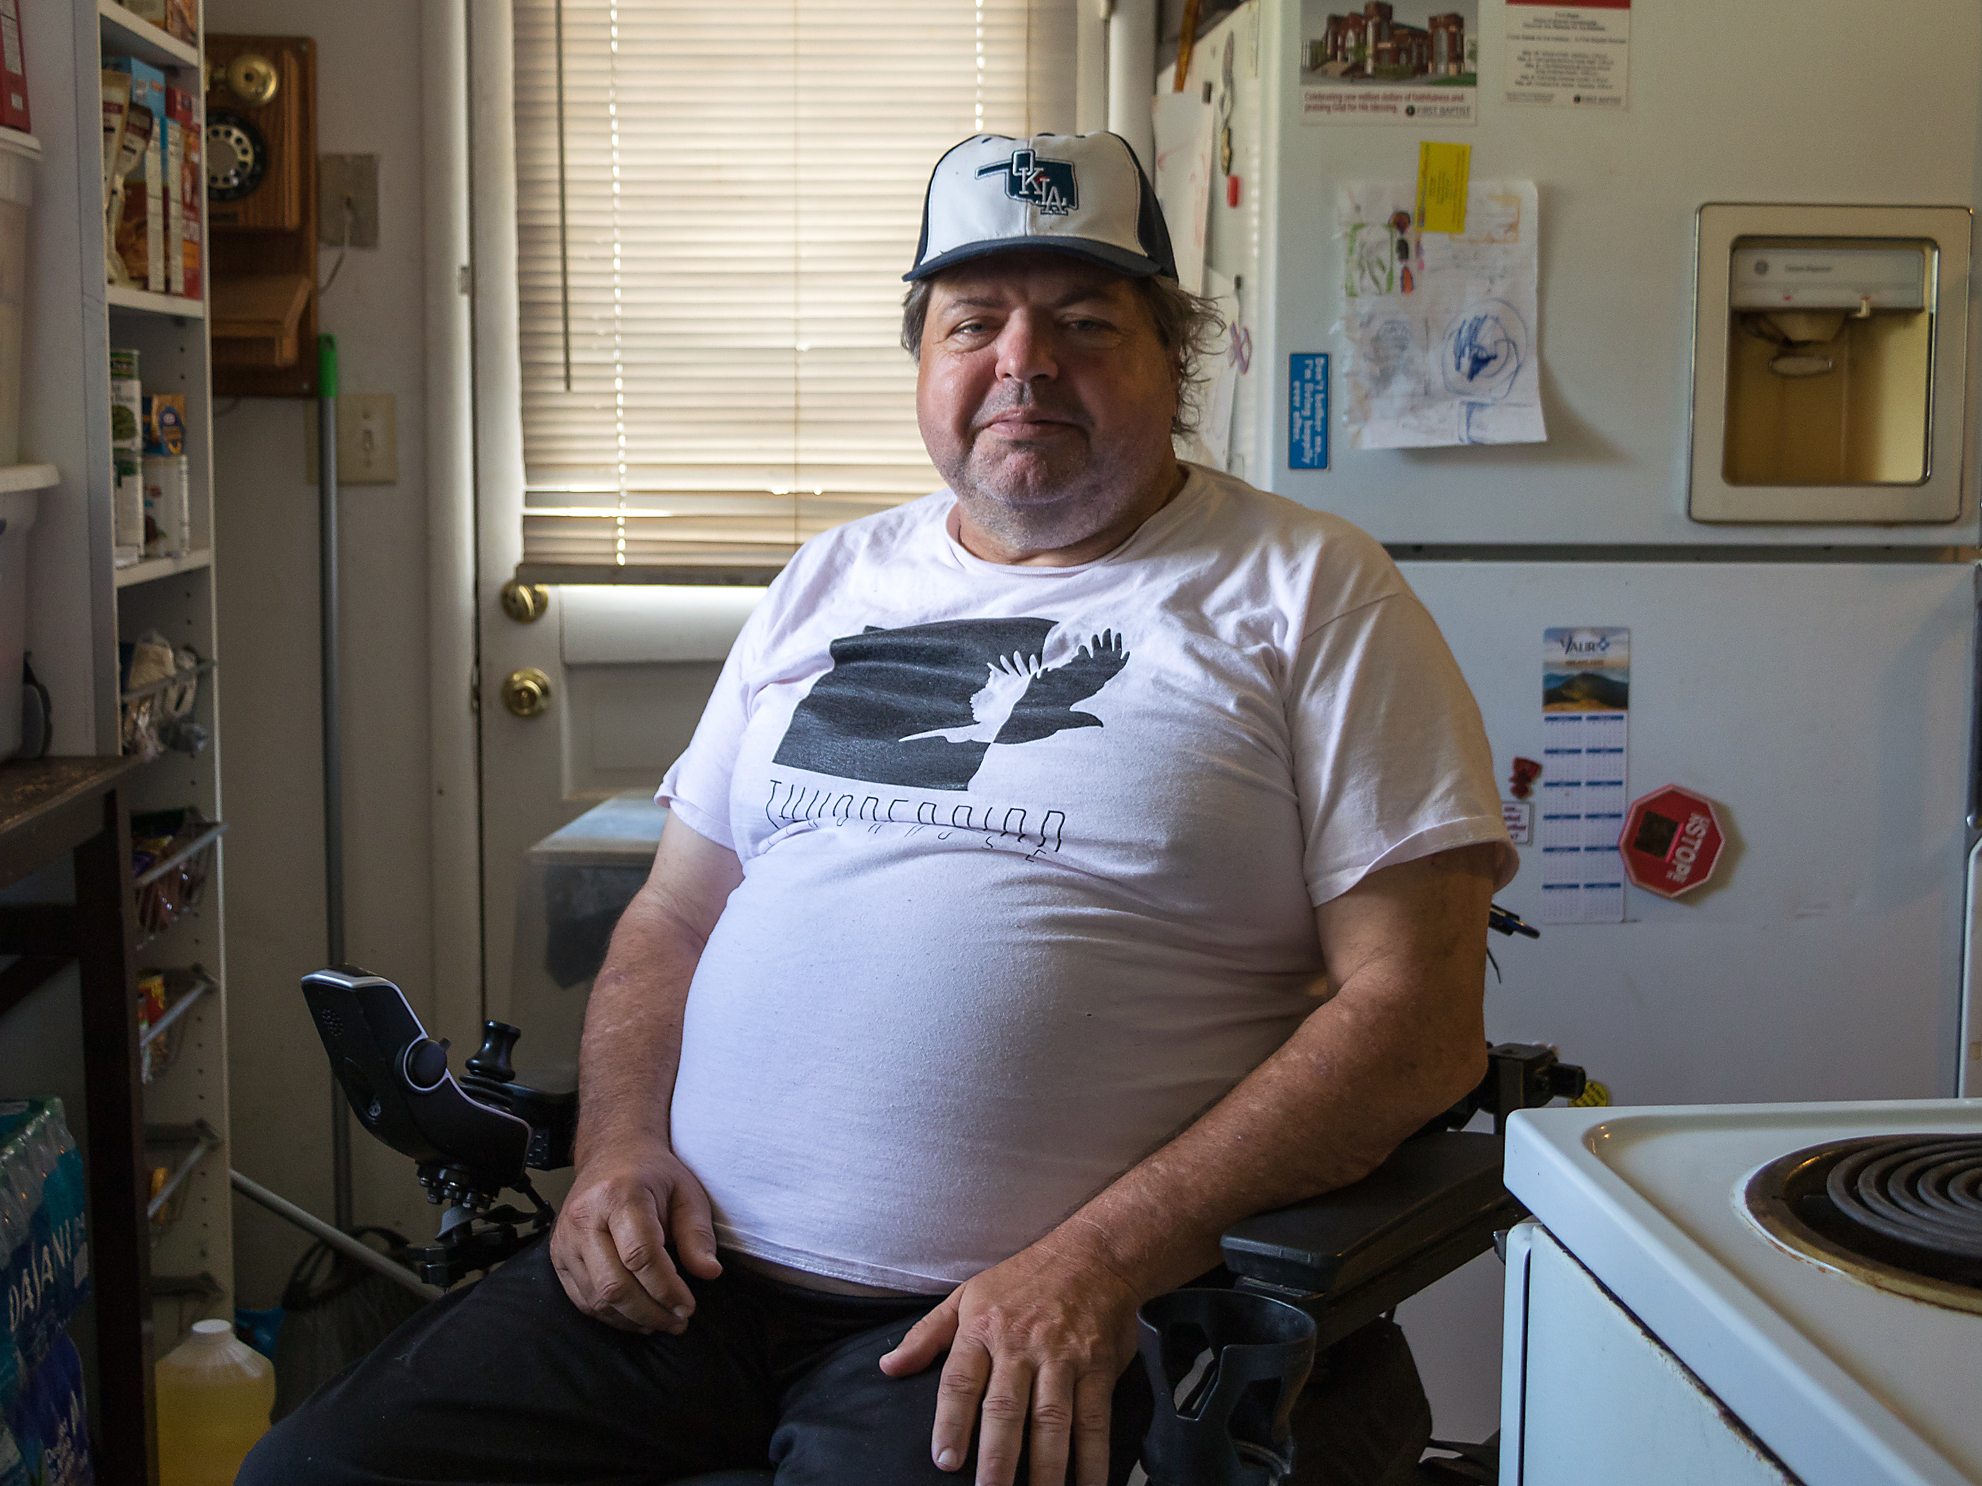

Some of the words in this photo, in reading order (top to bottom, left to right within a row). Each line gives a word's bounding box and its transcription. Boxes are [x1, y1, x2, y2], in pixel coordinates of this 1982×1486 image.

[1315, 357, 1325, 390] Don't
[1293, 380, 1301, 407] ever
[1302, 383, 1314, 417] living
[1315, 394, 1325, 432] bother
[1302, 420, 1313, 463] happily
